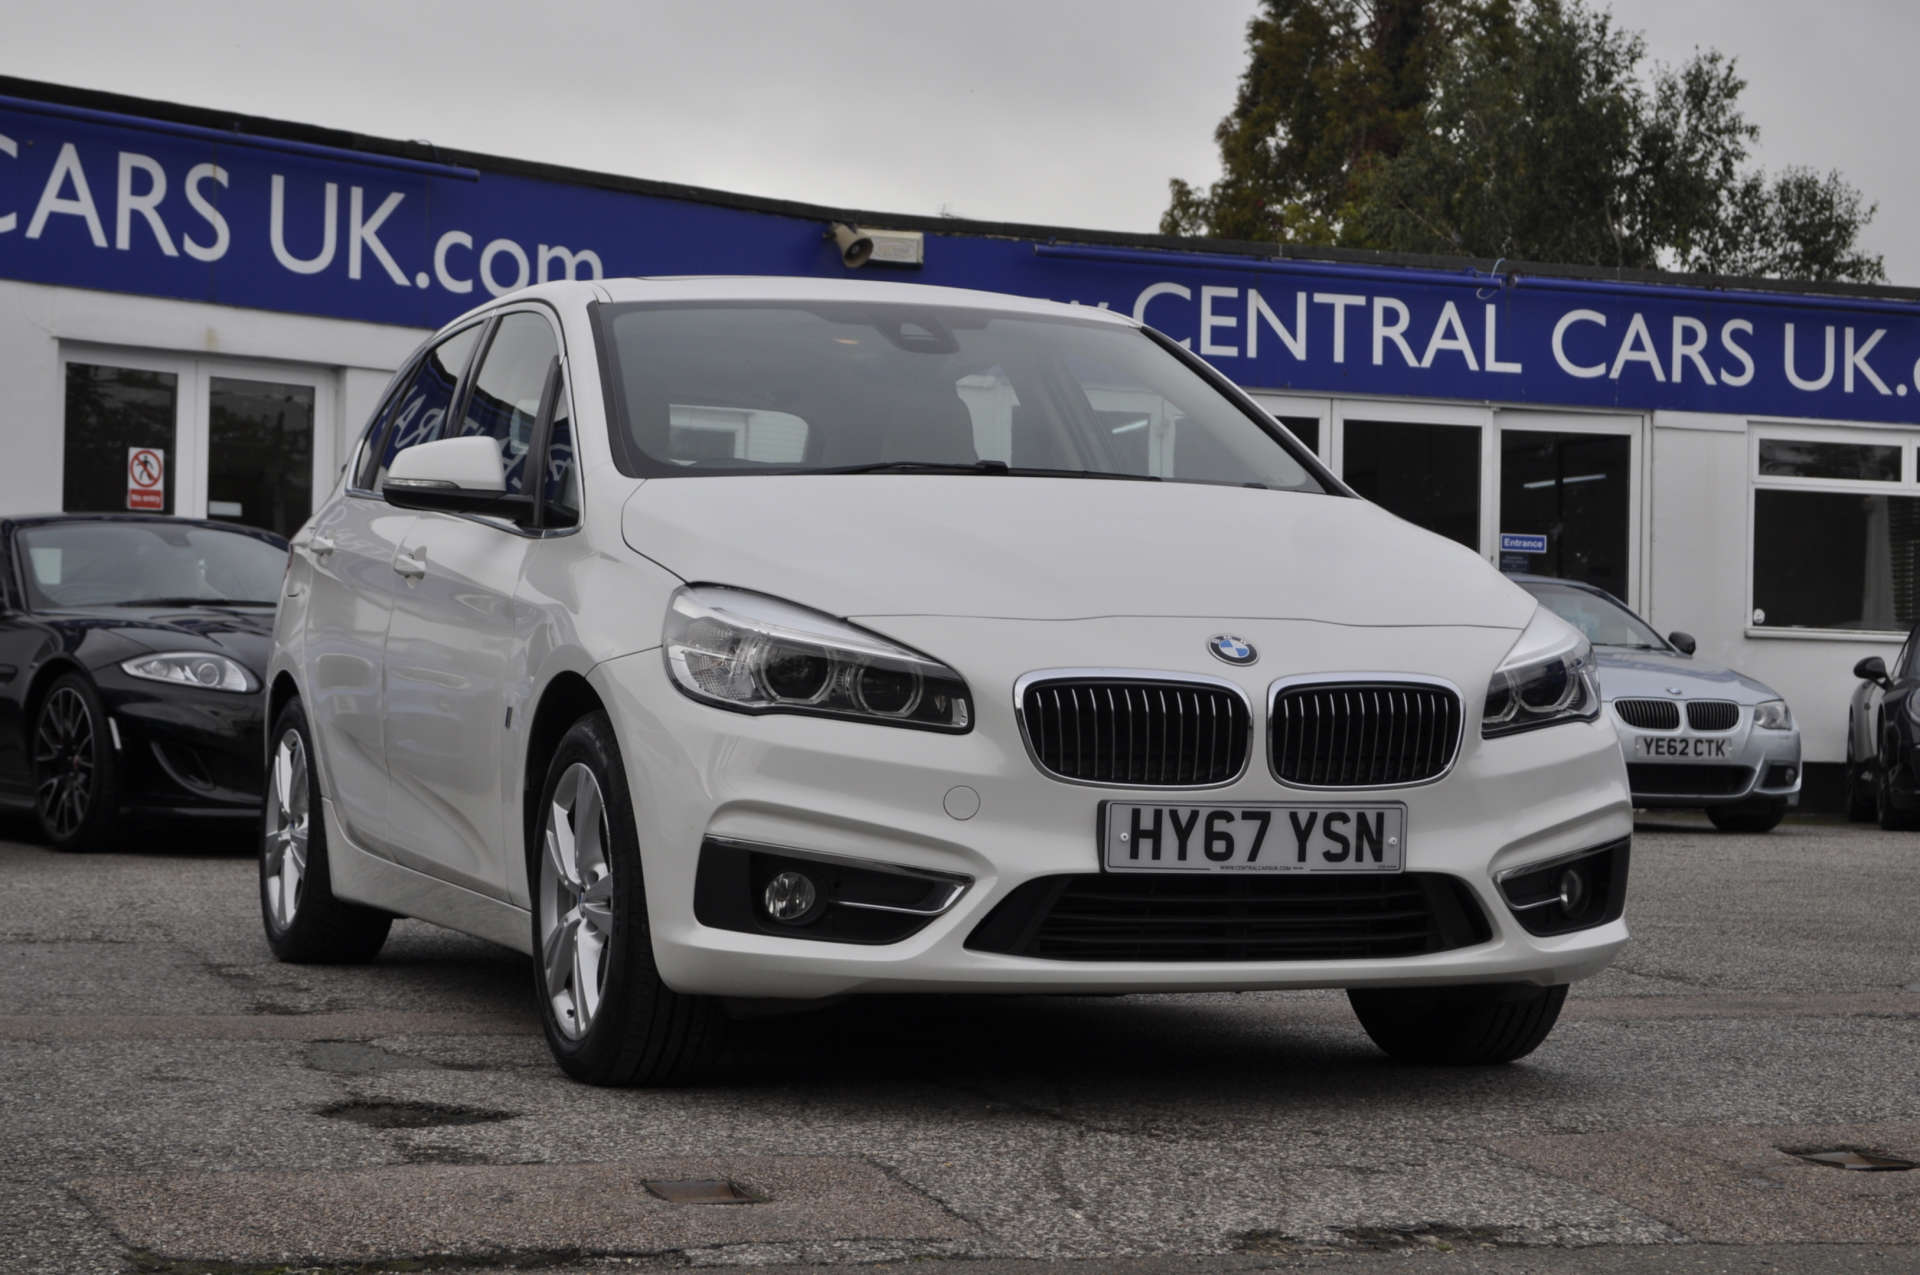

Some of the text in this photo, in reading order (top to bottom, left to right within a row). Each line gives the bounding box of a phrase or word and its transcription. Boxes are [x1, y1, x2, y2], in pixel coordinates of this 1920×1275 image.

[0, 134, 604, 298] ARS UK.com
[1132, 281, 1920, 397] CENTRAL CARS UK.
[1503, 537, 1543, 549] Entrance
[1643, 737, 1726, 757] YE62 CTK
[1129, 807, 1385, 863] HY67 YSN
